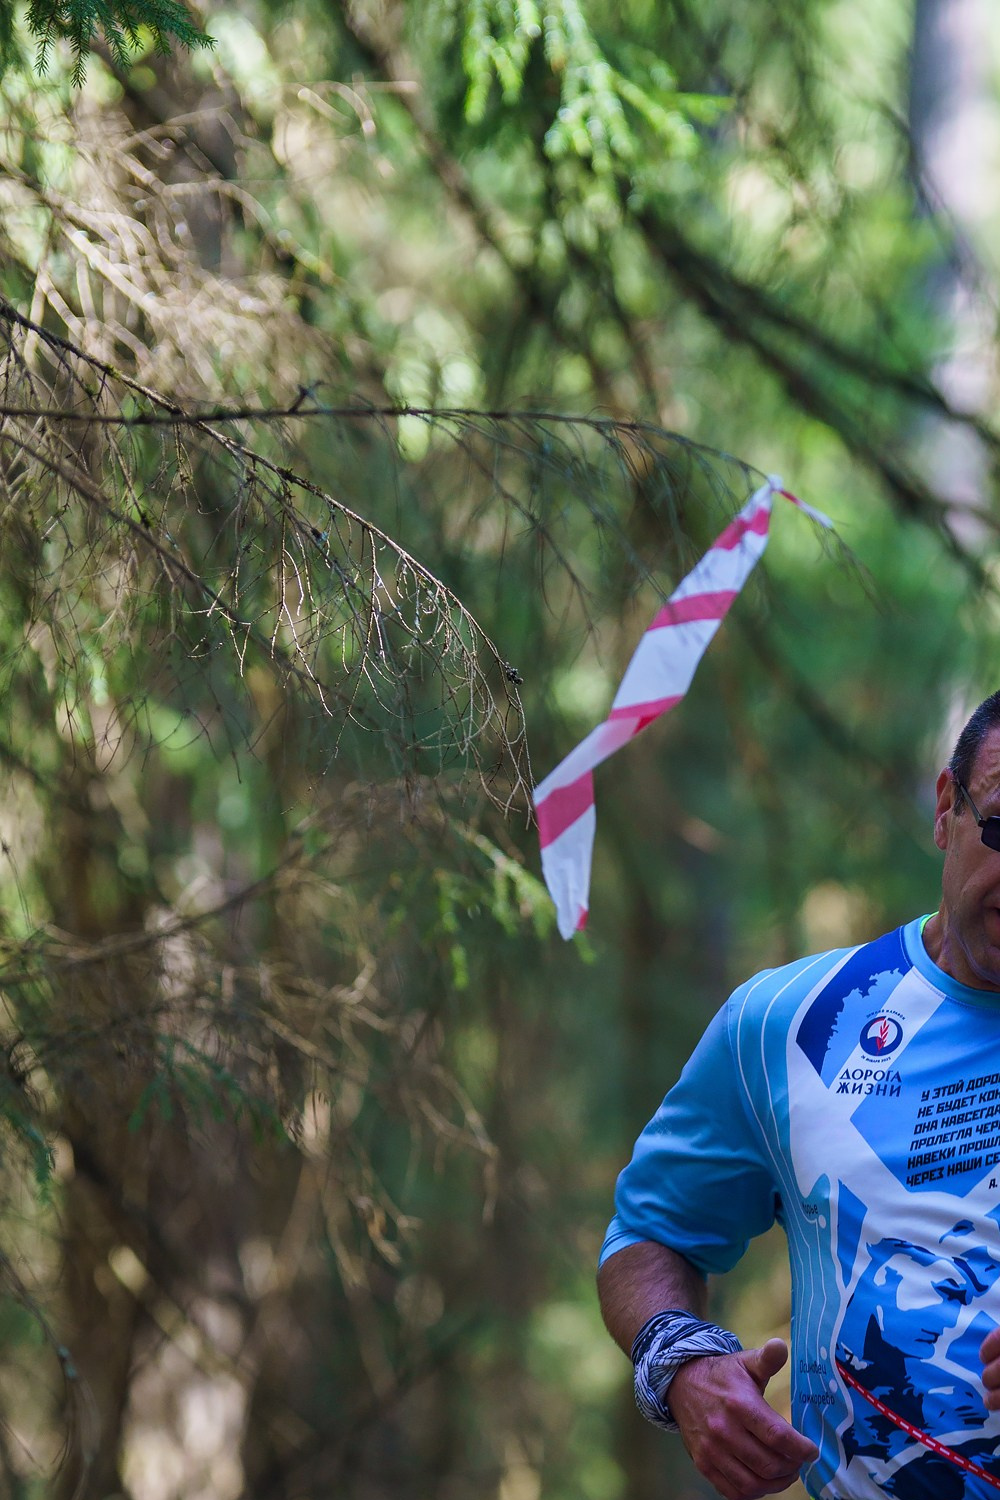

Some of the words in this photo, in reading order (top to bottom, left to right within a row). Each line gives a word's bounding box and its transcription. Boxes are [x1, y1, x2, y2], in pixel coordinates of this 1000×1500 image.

[839, 1068, 902, 1083] ДОРОГА
[836, 1081, 902, 1097] ЖИЗНИ
[921, 1089, 930, 1102] У
[932, 1080, 964, 1099] ЭТОЙ
[917, 1105, 934, 1119] НЕ
[936, 1094, 977, 1114] БУДЕТ
[914, 1120, 938, 1135] ОНА
[910, 1127, 972, 1151] ПРОЛЕГЛА
[907, 1146, 956, 1169] НАВЕКИ
[906, 1167, 945, 1187] ЧЕРЕЗ
[947, 1157, 982, 1176] НАШИ
[988, 1178, 998, 1189] А.
